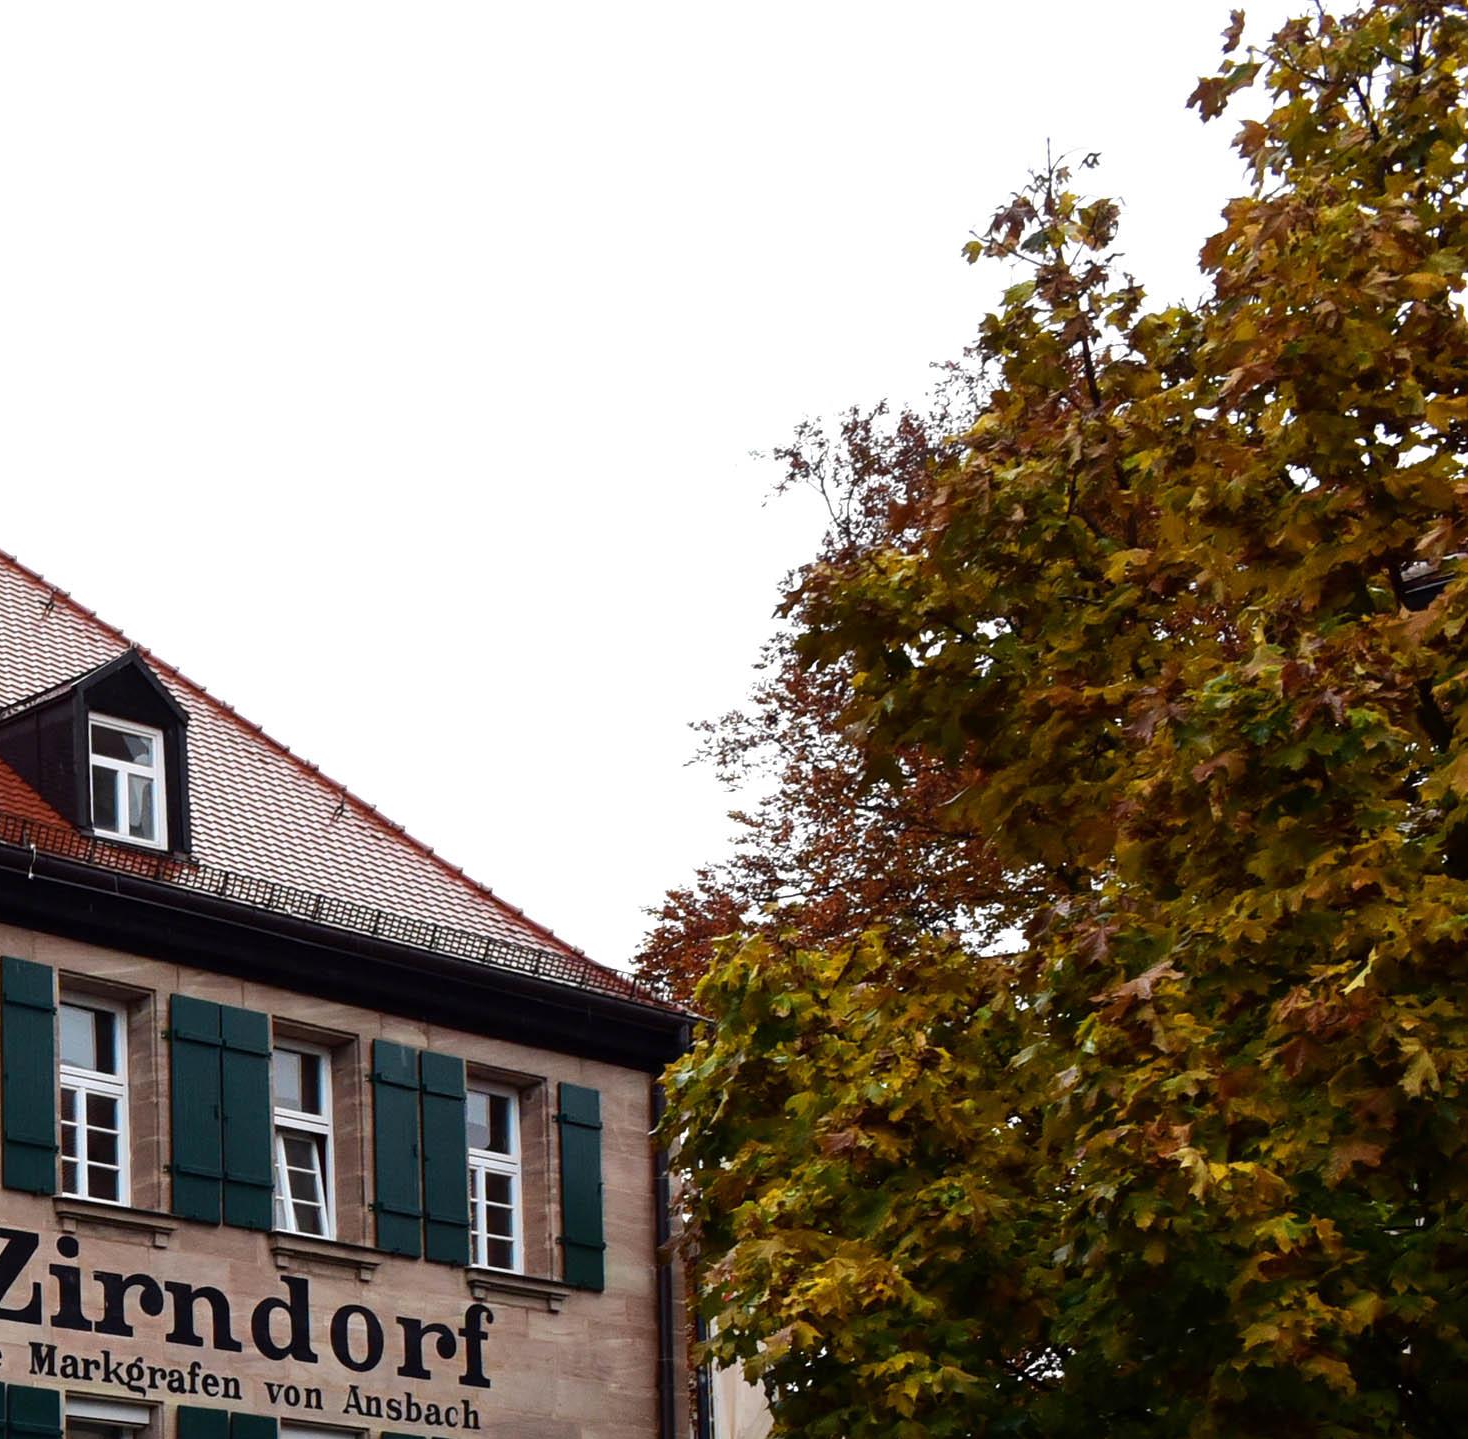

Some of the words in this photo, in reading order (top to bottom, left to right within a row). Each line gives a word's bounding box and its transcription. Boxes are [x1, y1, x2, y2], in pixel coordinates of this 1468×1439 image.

[28, 1341, 243, 1401] Markgrafen
[264, 1381, 324, 1411] von
[342, 1384, 481, 1430] Ansbach
